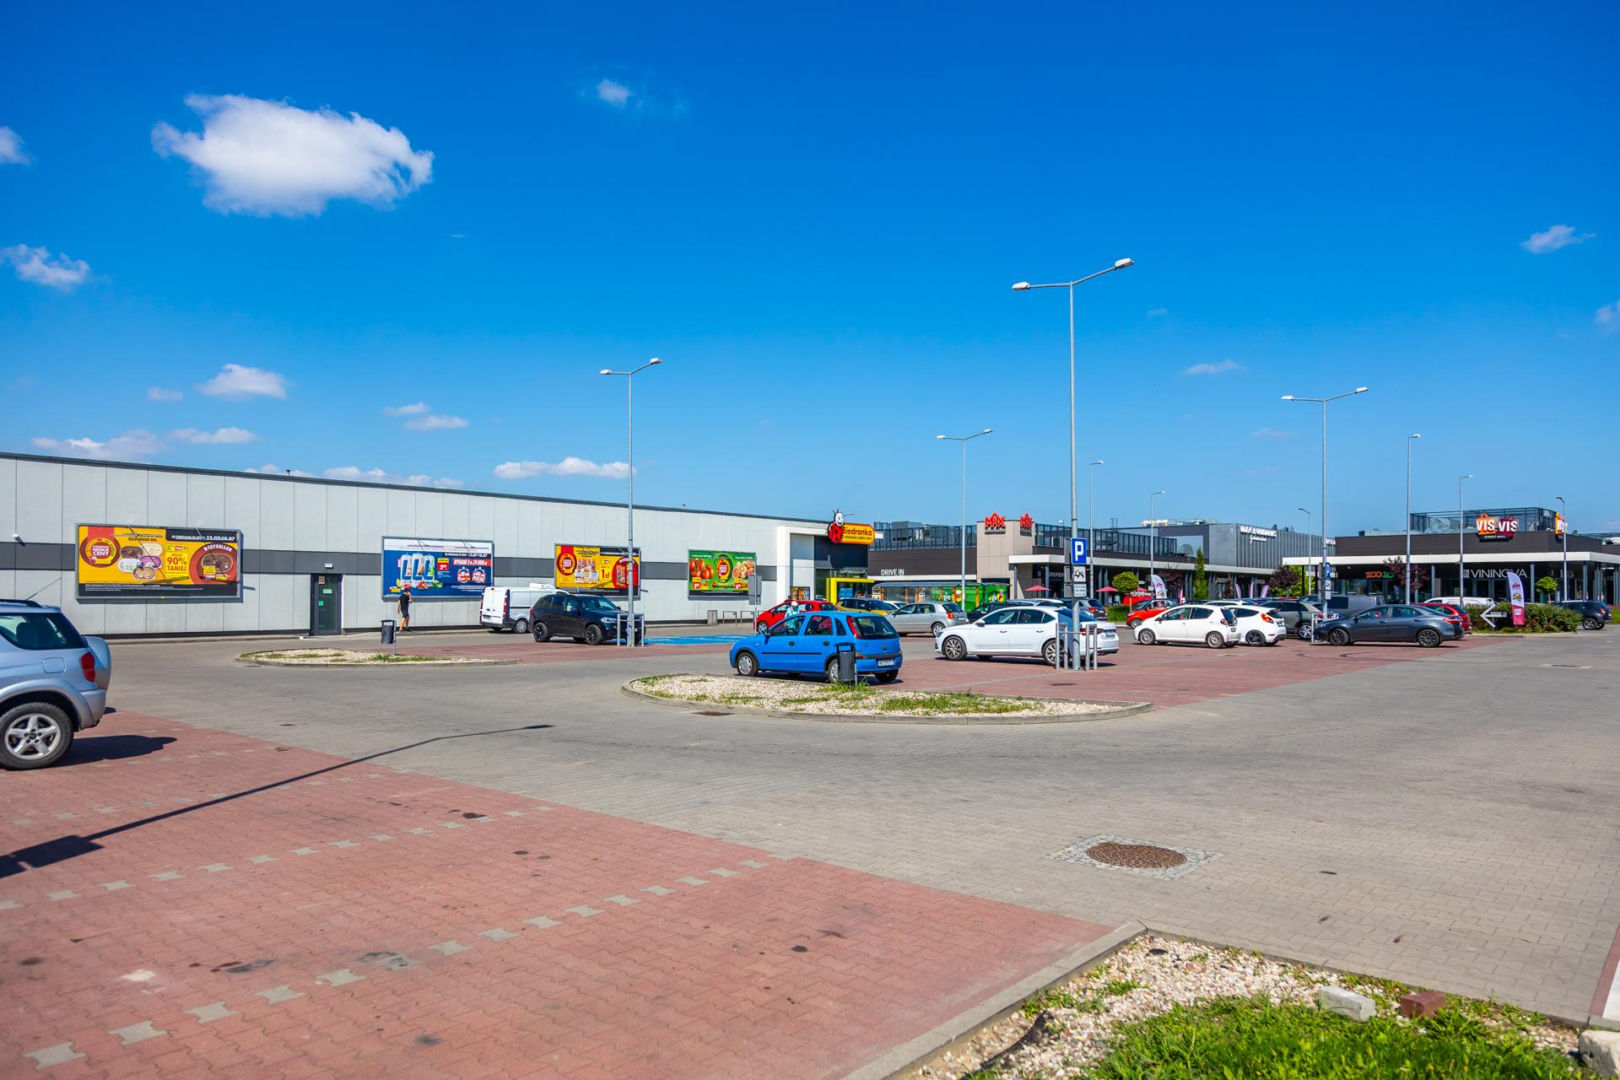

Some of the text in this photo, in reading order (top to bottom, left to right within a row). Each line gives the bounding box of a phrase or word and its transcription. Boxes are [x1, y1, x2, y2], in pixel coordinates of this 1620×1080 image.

[985, 512, 1006, 527] MAX
[1476, 519, 1518, 532] VIS VIS
[1075, 541, 1084, 561] P
[167, 557, 187, 565] 90%
[880, 568, 905, 576] DRIVE IN
